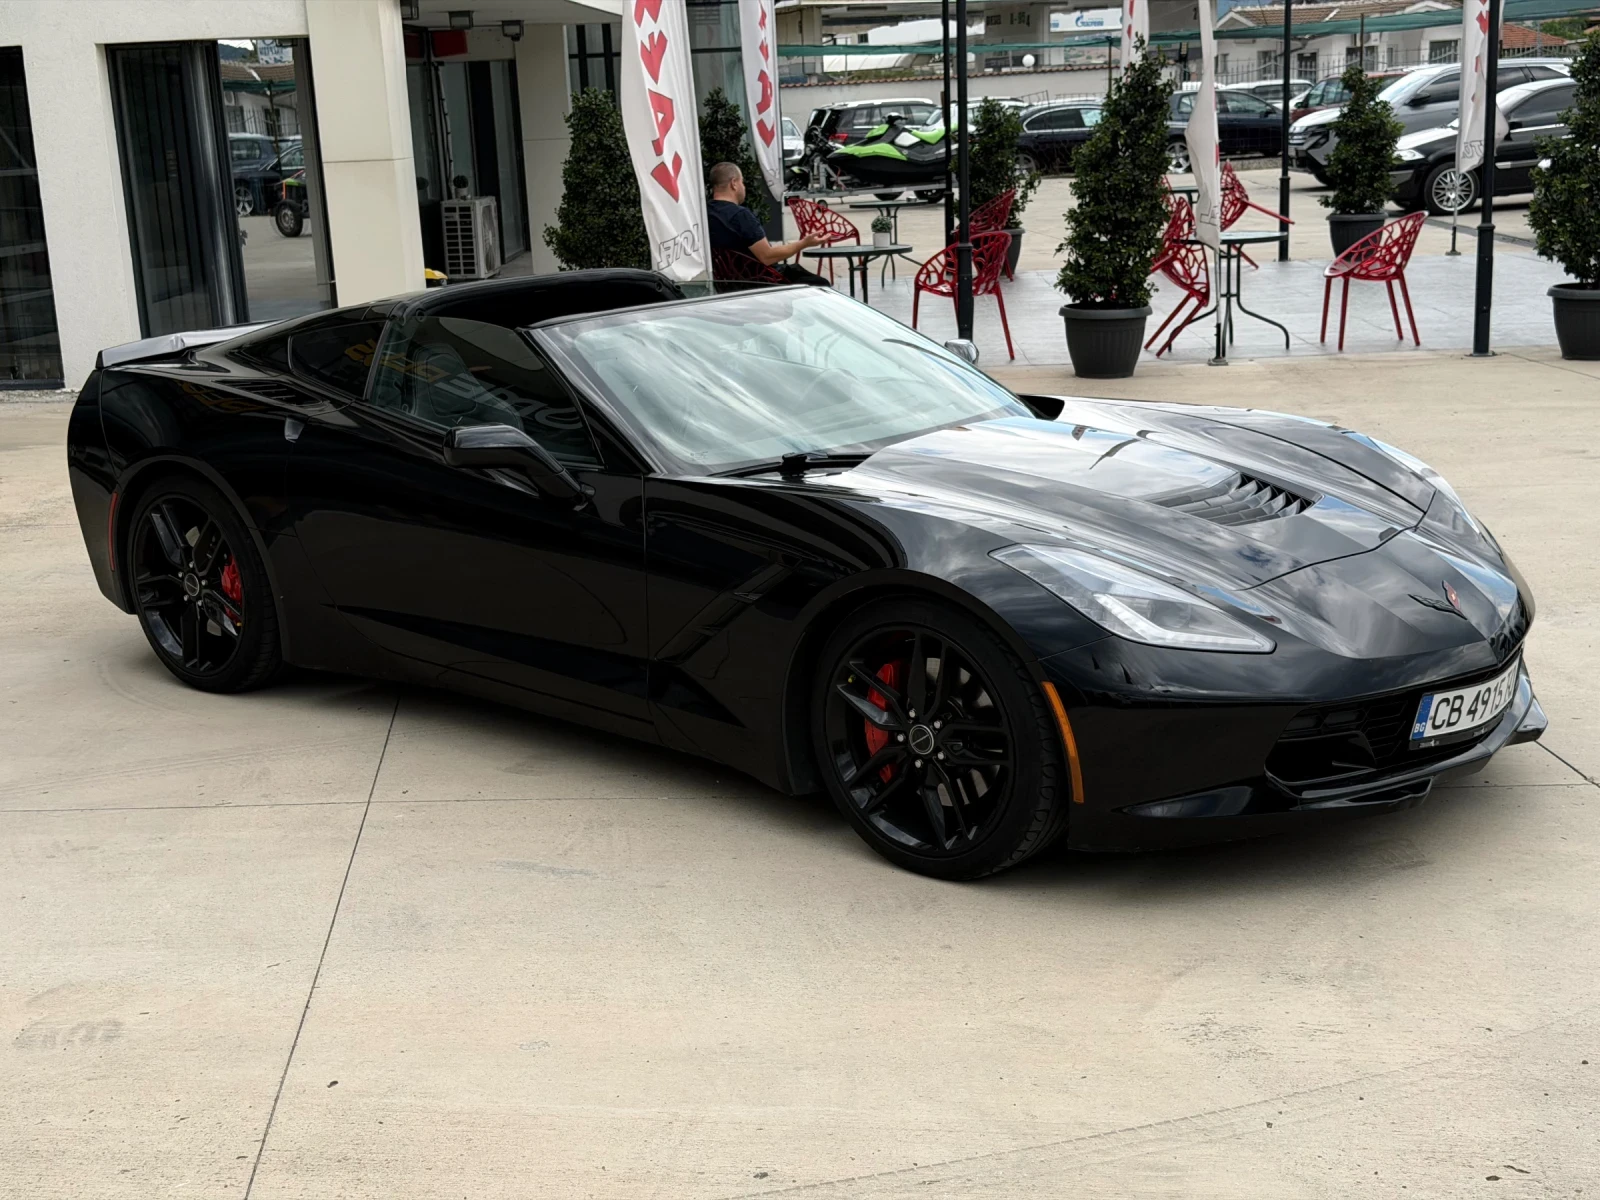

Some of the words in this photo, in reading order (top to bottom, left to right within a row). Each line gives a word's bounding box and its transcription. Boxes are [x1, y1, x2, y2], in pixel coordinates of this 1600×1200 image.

[1431, 694, 1465, 730] CB
[1466, 676, 1506, 722] 4915
[1414, 722, 1426, 733] BG
